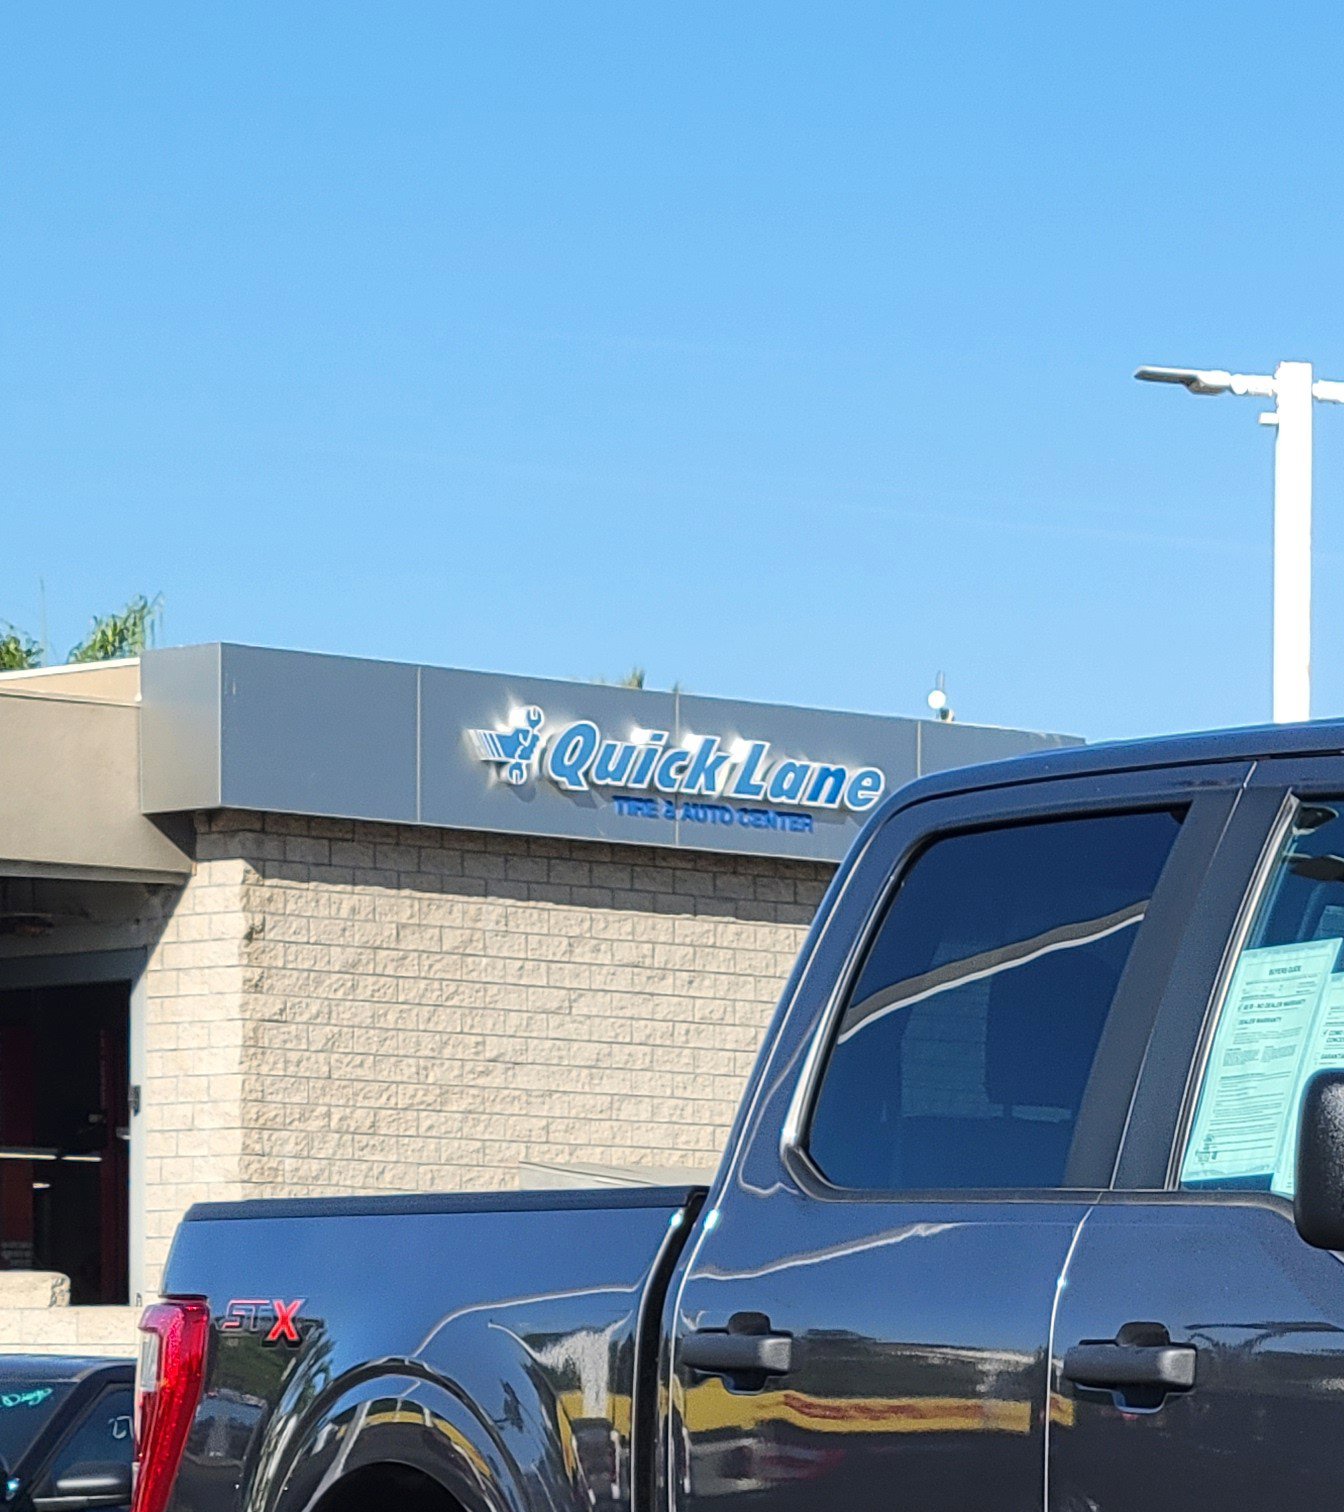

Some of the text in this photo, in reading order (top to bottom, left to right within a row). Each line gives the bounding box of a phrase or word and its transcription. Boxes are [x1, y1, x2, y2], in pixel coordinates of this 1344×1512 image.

[548, 720, 886, 812] Quick Lane
[612, 796, 814, 833] TIRE & AUTO CENTER
[218, 1298, 305, 1343] STX
